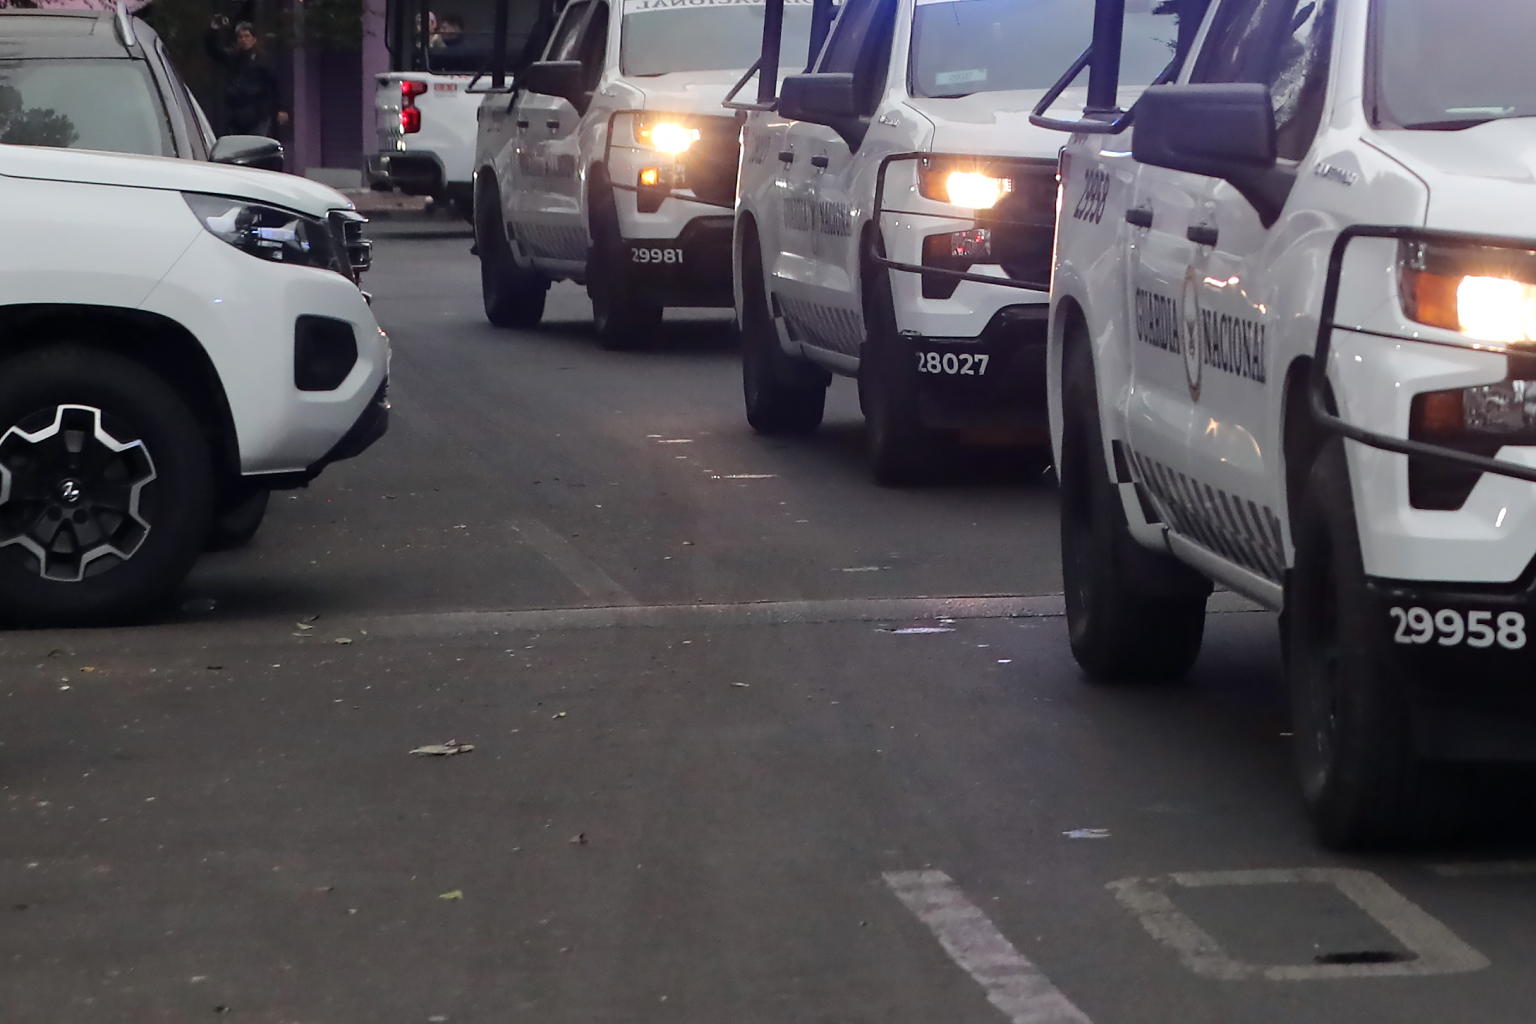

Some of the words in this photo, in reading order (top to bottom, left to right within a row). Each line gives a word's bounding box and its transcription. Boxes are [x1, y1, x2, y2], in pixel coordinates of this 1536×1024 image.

[631, 247, 683, 263] 29981
[915, 351, 990, 375] 28027
[1201, 308, 1267, 384] NACIONAL
[1390, 606, 1527, 650] 29958
